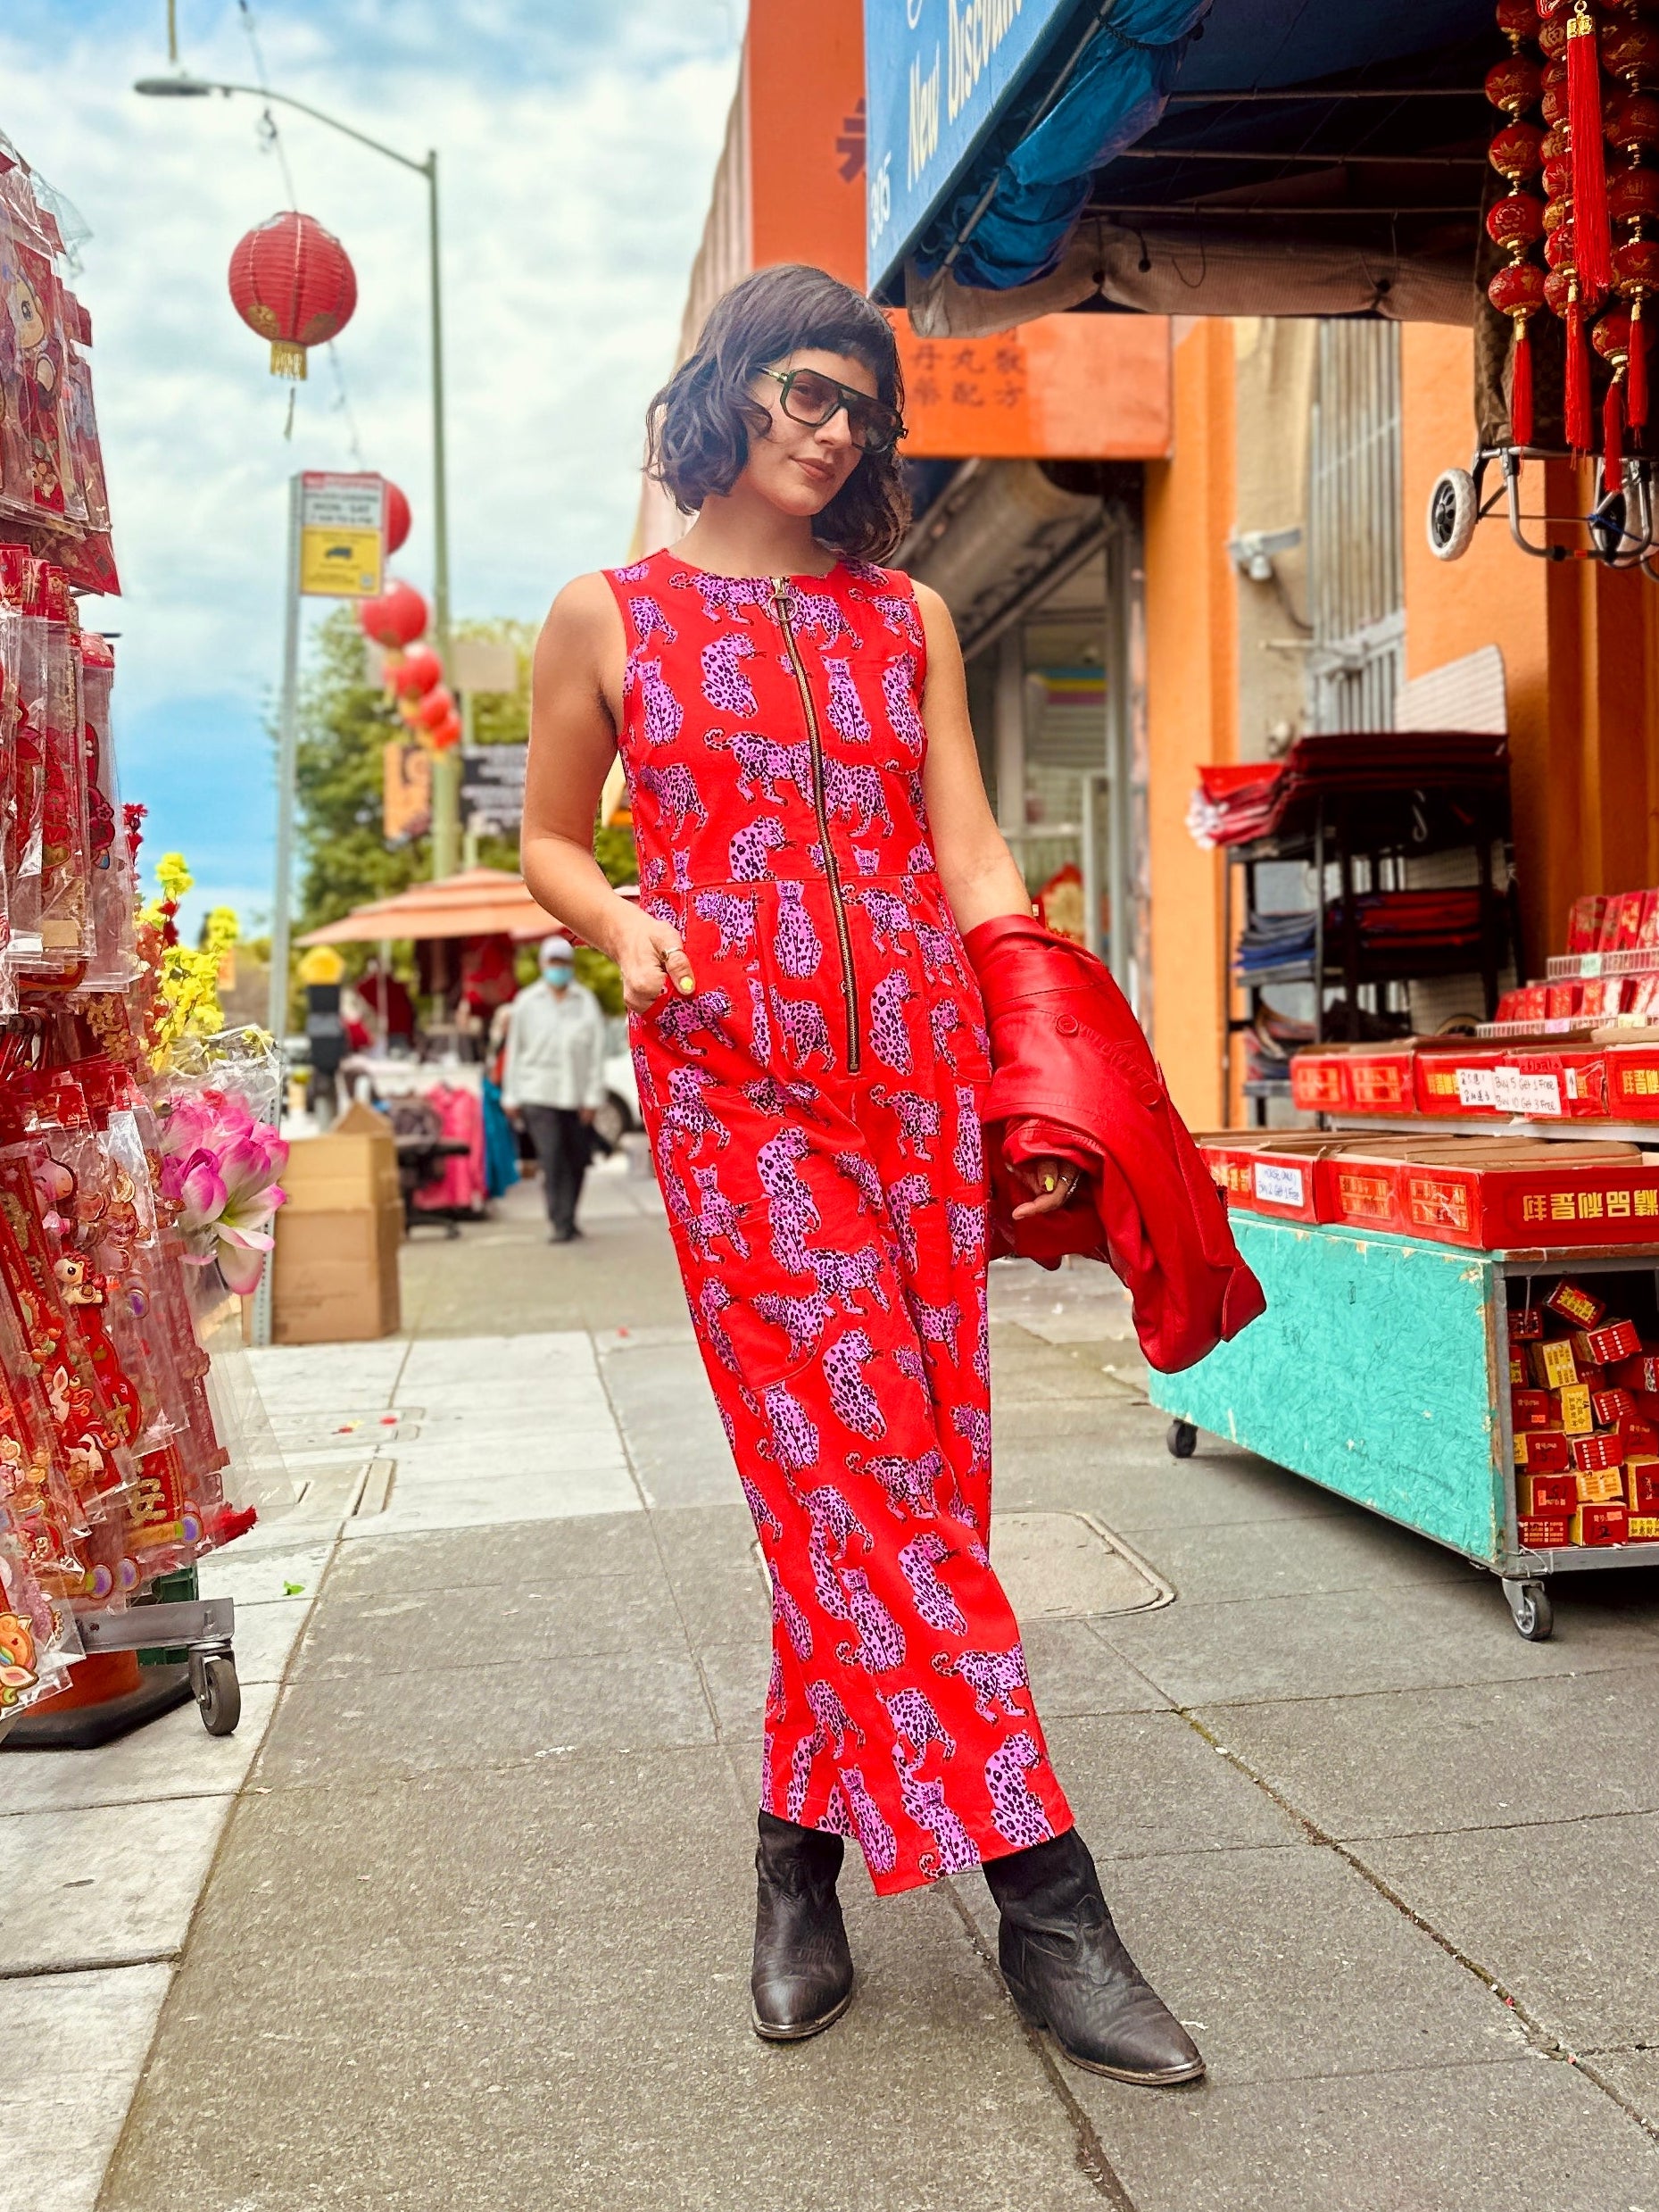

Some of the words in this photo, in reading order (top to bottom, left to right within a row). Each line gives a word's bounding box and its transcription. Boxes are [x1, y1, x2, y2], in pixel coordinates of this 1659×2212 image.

[908, 40, 941, 193] New
[948, 0, 1023, 126] Discoun
[1510, 1077, 1517, 1089] 5
[1539, 1078, 1555, 1091] Free
[1539, 1099, 1557, 1111] Free
[1522, 1188, 1659, 1222] 精品利是封
